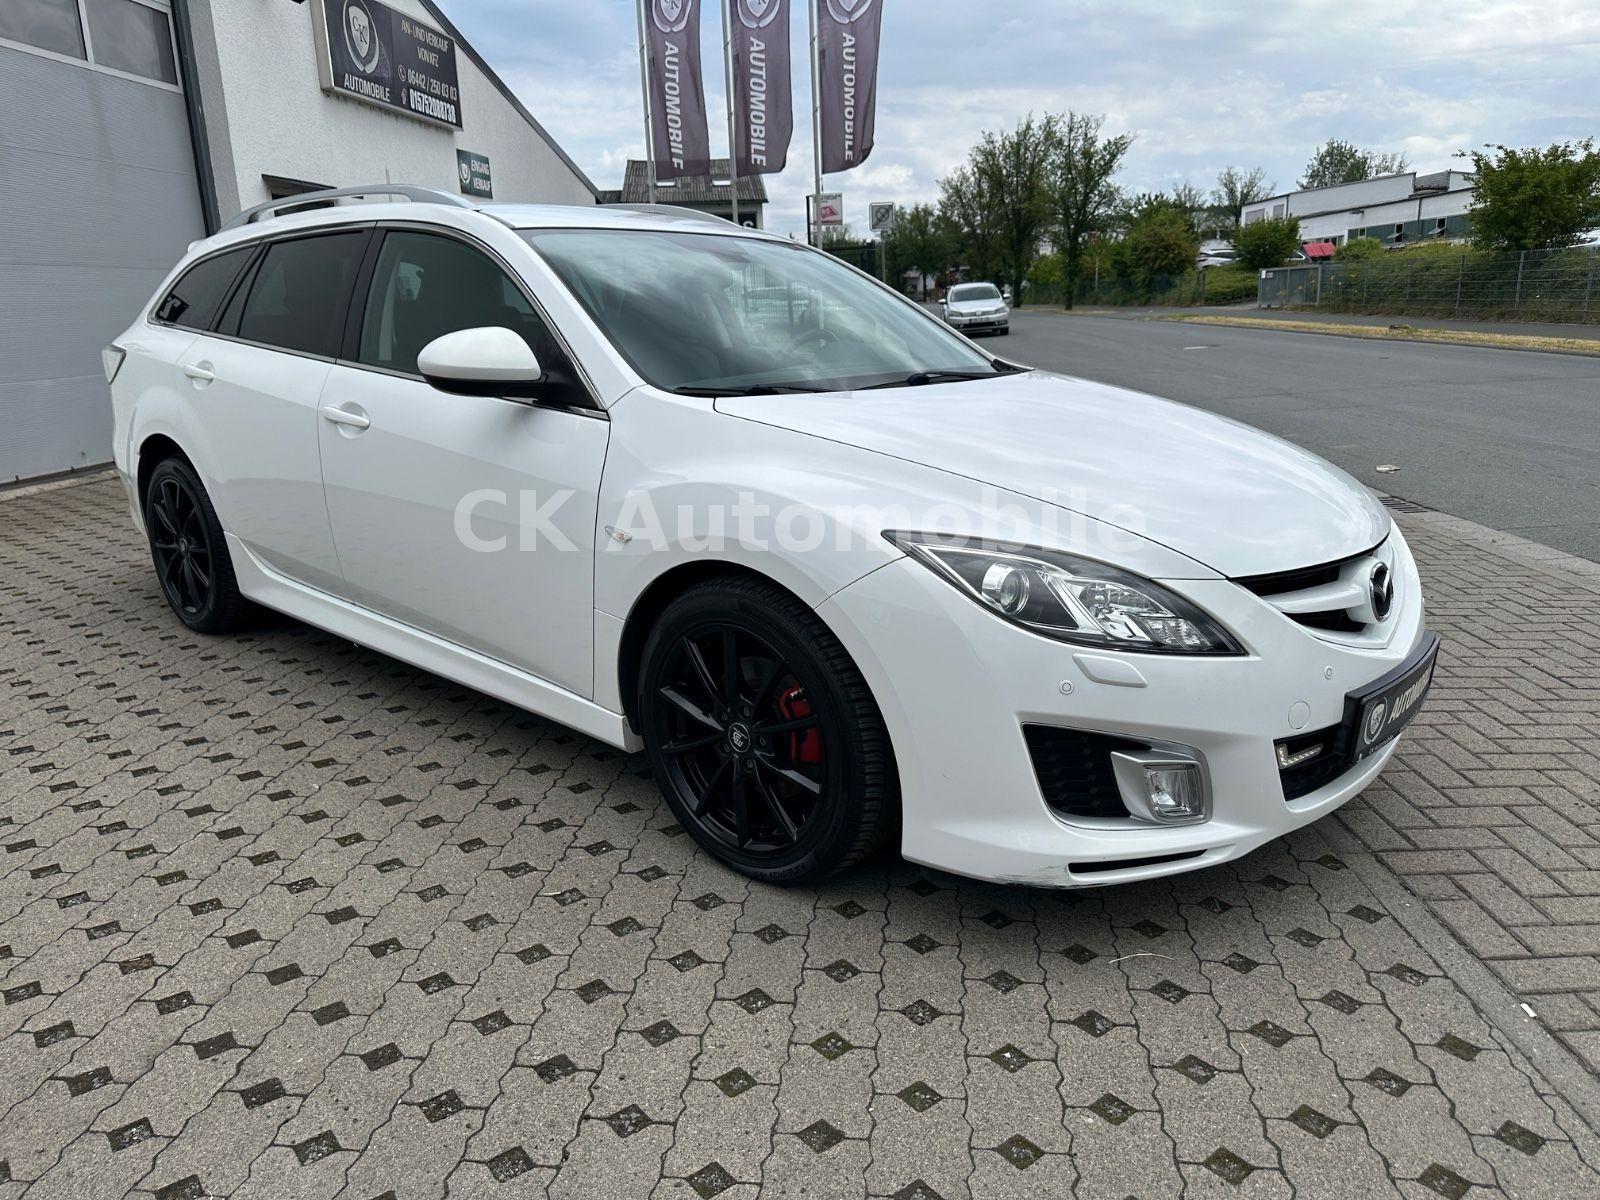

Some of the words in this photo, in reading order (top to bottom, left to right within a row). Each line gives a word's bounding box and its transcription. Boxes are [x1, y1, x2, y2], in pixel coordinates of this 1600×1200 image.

[412, 25, 425, 42] UND
[425, 31, 449, 53] VERKAUF
[417, 45, 430, 63] VON
[344, 73, 390, 102] AUTOMOBILE
[407, 68, 426, 90] 06442
[430, 78, 441, 96] 250
[441, 83, 450, 98] 03
[450, 86, 458, 101] 03
[843, 32, 856, 161] AUTOMOBILE
[664, 41, 684, 170] AUTOMOBILE
[750, 36, 766, 167] AUTOMOBILE
